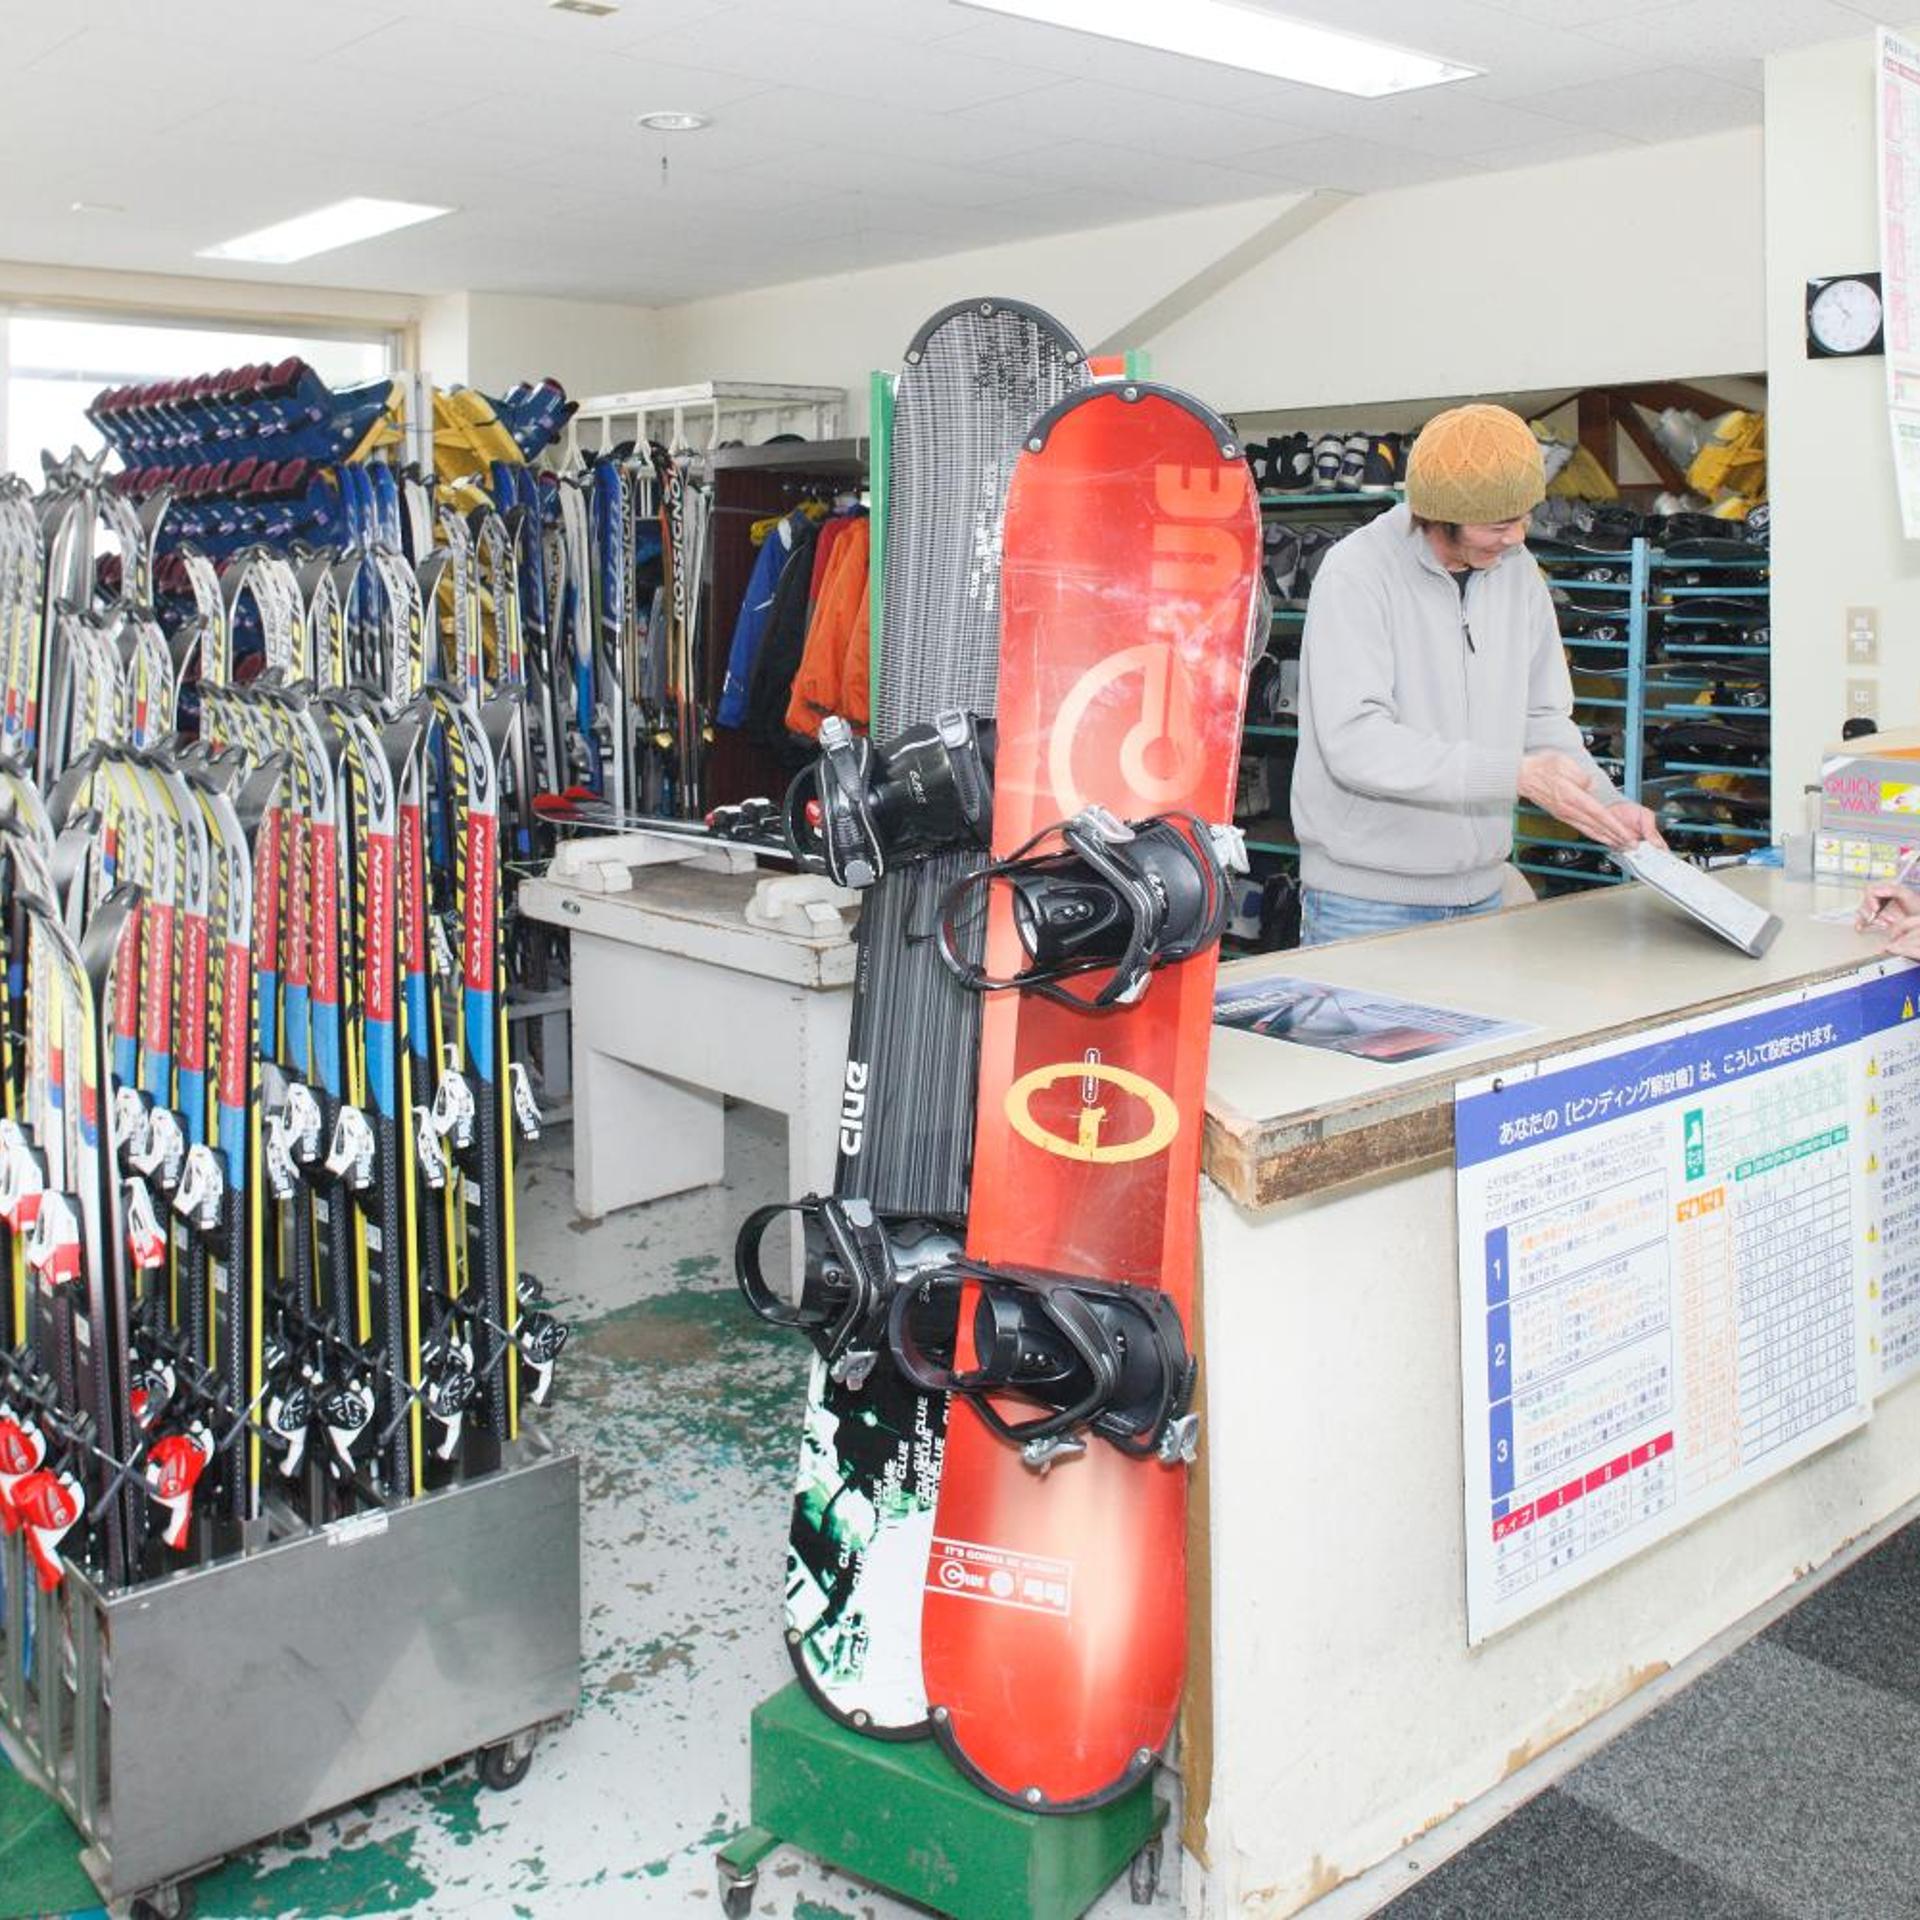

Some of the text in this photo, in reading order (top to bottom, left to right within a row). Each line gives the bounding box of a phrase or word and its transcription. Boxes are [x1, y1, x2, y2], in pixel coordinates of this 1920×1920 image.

[667, 463, 686, 622] ROSSIGNOL
[1823, 775, 1881, 797] QUICK
[1839, 796, 1881, 816] WAX
[291, 823, 303, 977] SALOMON
[316, 834, 327, 995] SALOMON
[372, 844, 383, 1012] SALOMON
[403, 815, 414, 965] SALOMON
[472, 824, 486, 982] SALOMON
[186, 923, 197, 1061] SALOMON
[226, 953, 239, 1096] SALOMON
[840, 1061, 868, 1156] clue
[1492, 1258, 1501, 1282] 1
[1495, 1343, 1506, 1367] 2
[896, 1440, 909, 1481] CLUE
[915, 1395, 929, 1436] CLUE
[1497, 1439, 1508, 1463] 3
[1495, 1508, 1533, 1537] タイプ
